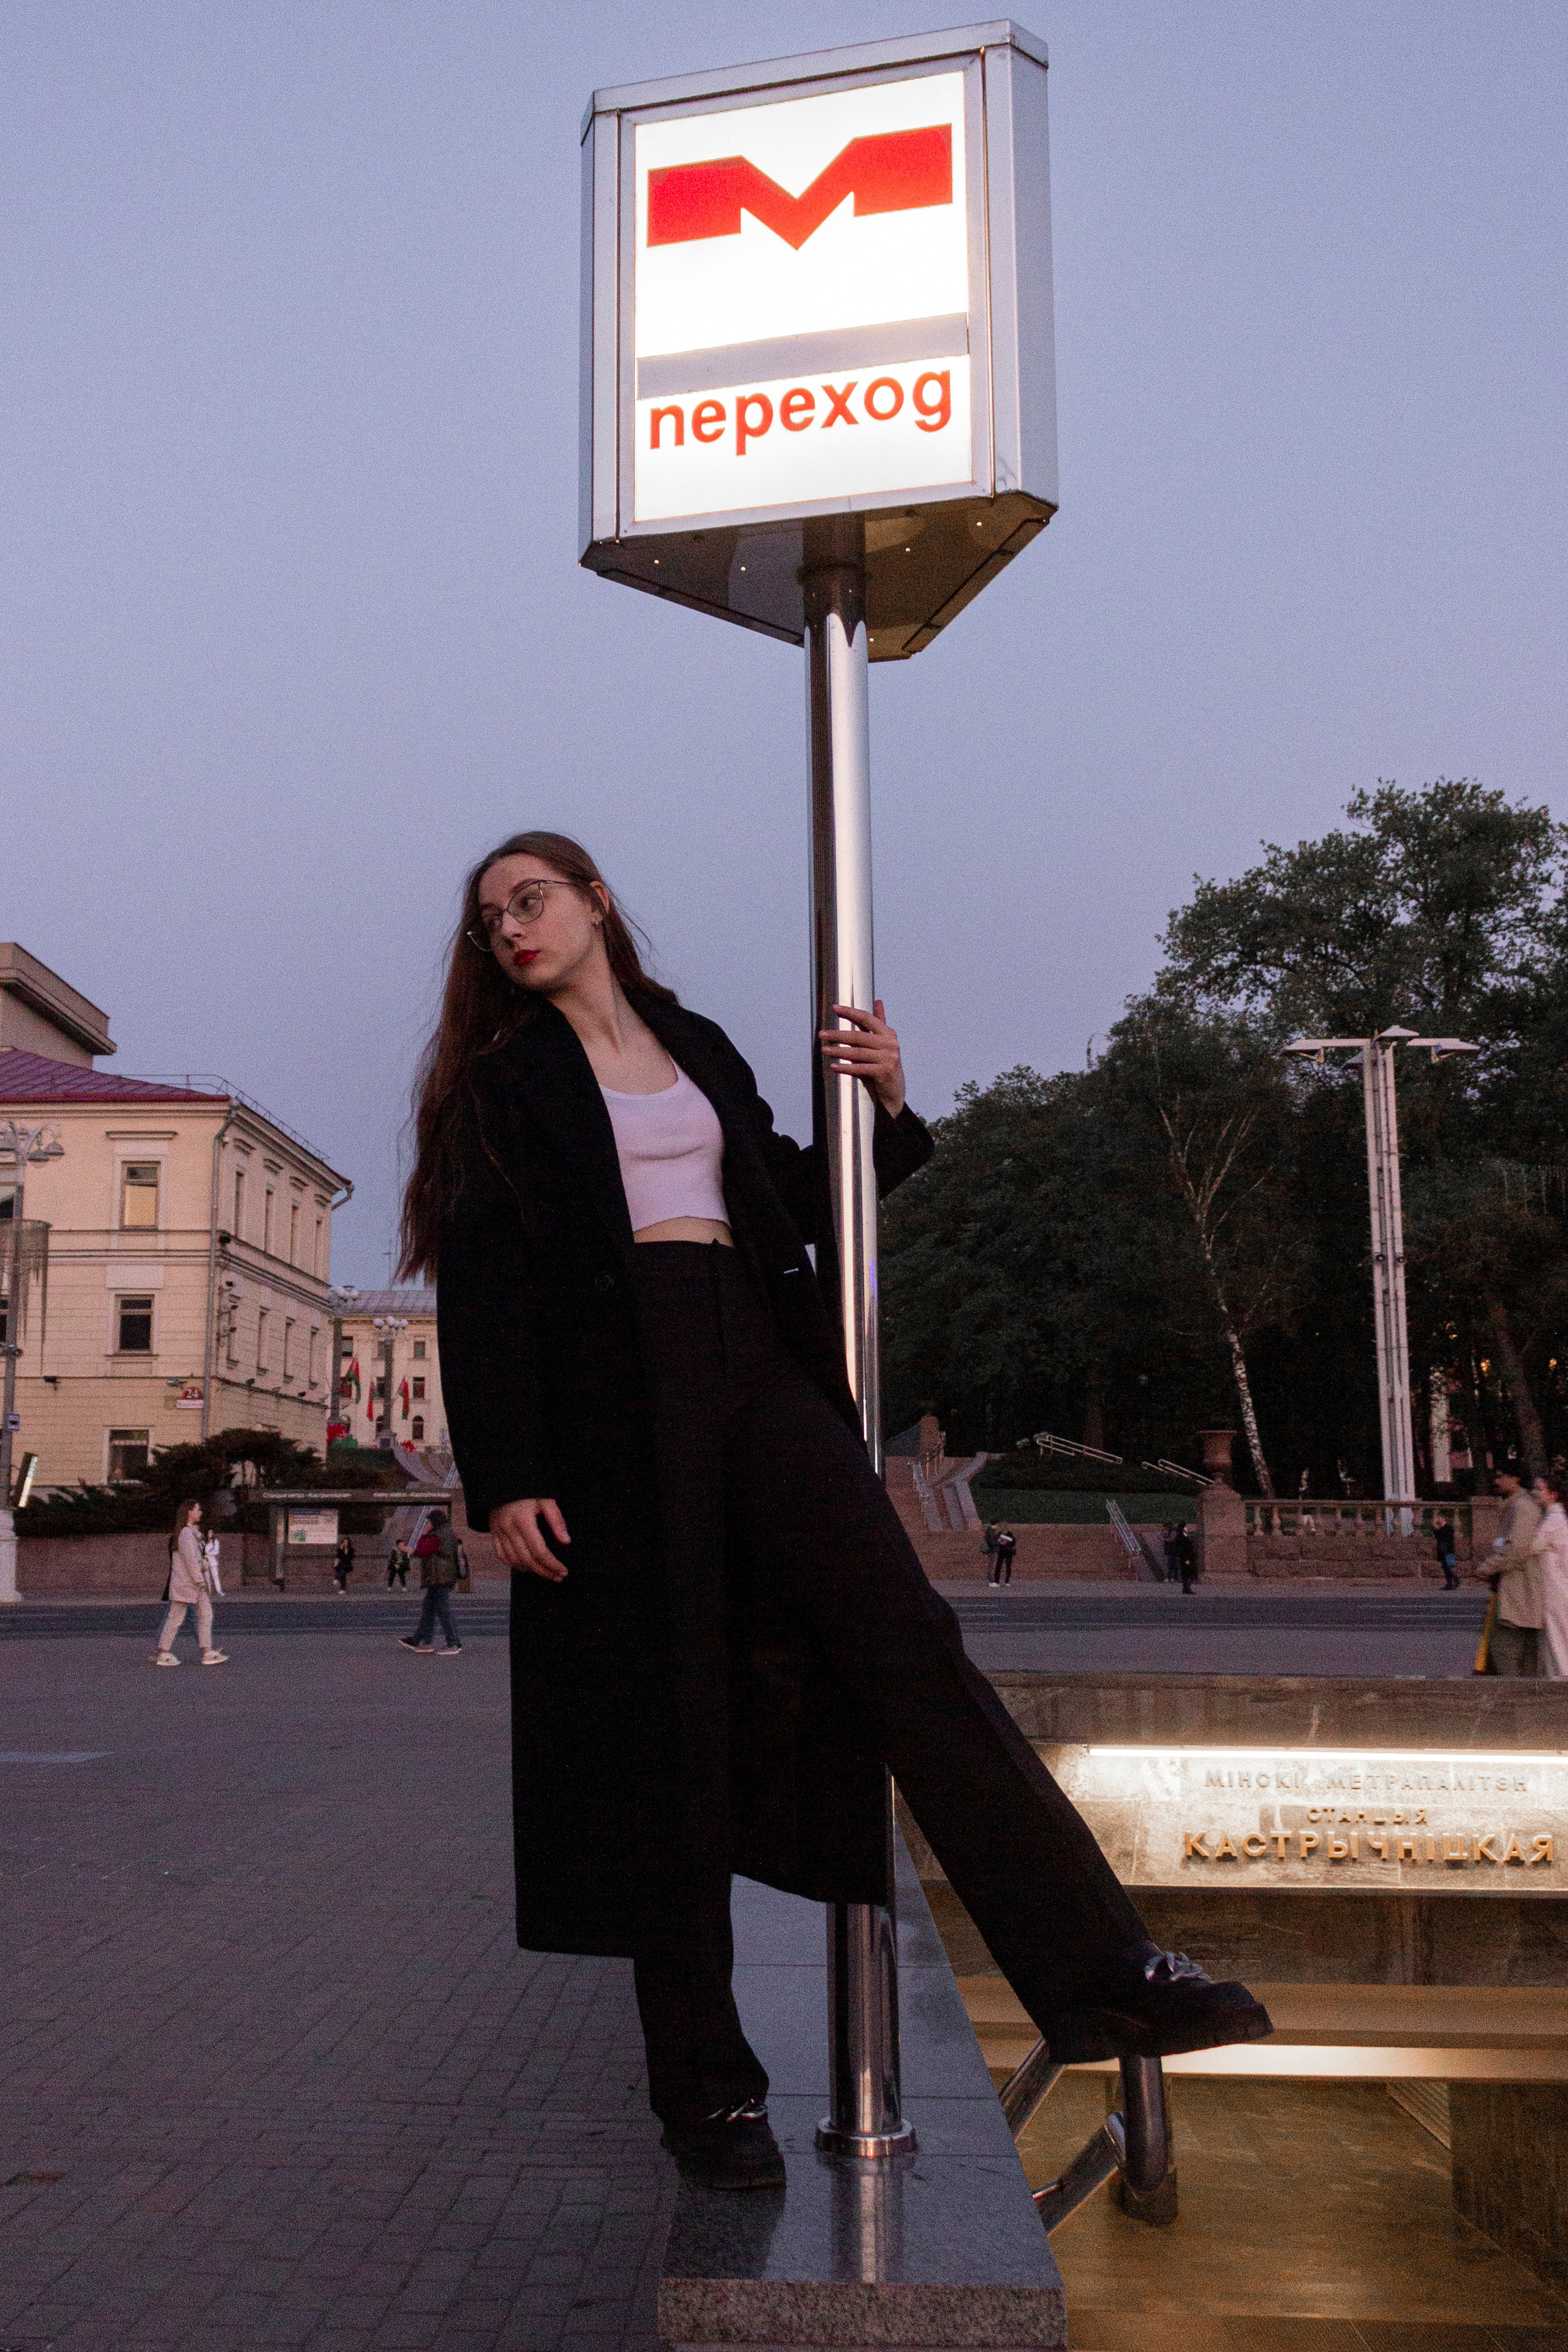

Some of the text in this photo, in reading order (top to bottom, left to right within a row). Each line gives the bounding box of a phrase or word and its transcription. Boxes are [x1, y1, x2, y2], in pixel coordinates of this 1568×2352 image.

[186, 1389, 199, 1398] 24
[1205, 1770, 1527, 1792] МІНСКІ МЕТРАПАЛІТЭН
[1306, 1807, 1427, 1823] СТАНЦЫЯ
[1184, 1828, 1553, 1862] КАСТРЫЧНІЦКАЯ
